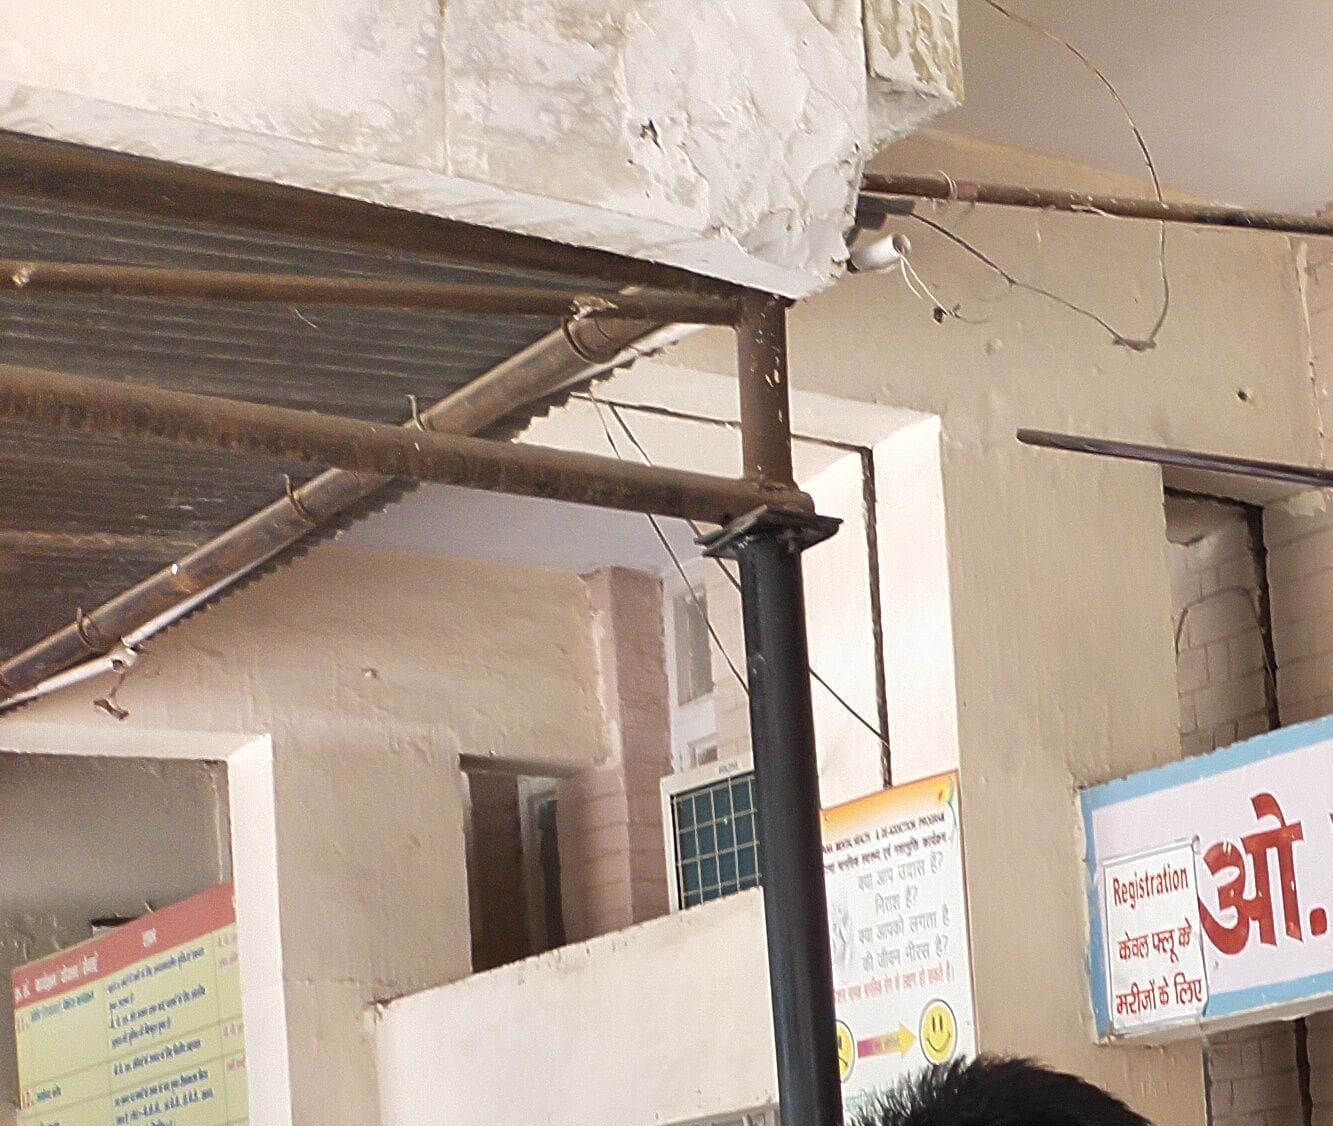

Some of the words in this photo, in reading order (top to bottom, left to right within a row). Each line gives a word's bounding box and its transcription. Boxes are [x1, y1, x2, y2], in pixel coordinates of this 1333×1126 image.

[1112, 862, 1189, 910] Registration
[1199, 792, 1328, 955] ओ.
[908, 910, 938, 934] लगता
[1116, 931, 1149, 962] केवल
[1151, 927, 1179, 963] फ्लू
[1177, 916, 1193, 948] के
[1116, 978, 1157, 1016] मरीजों
[1157, 973, 1170, 1007] के
[1173, 971, 1202, 1006] लिए
